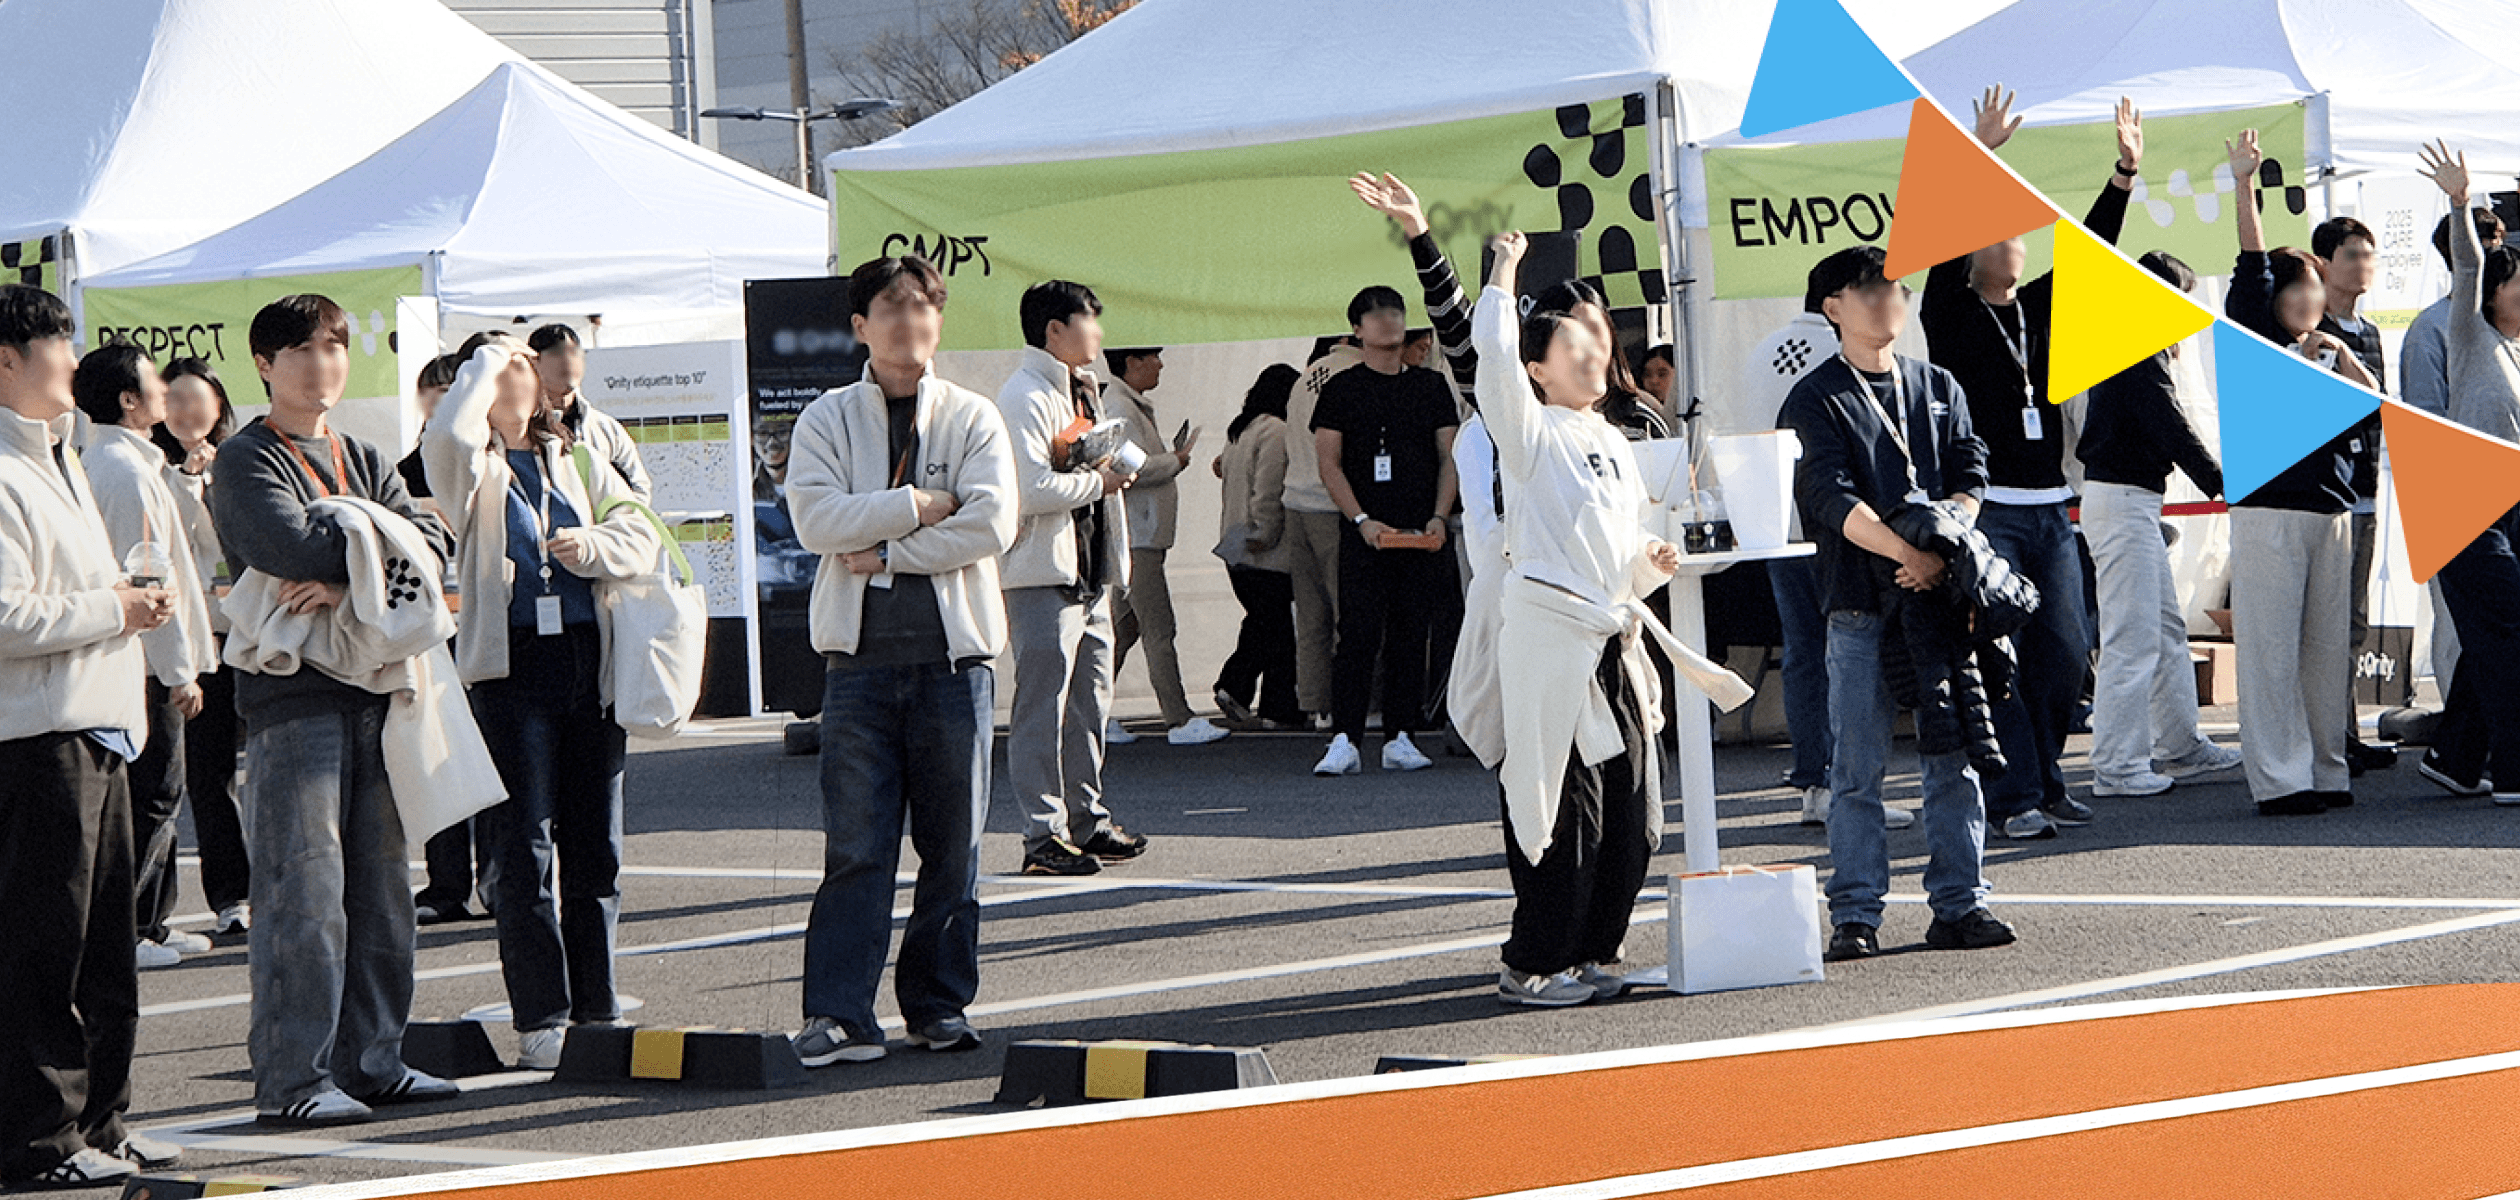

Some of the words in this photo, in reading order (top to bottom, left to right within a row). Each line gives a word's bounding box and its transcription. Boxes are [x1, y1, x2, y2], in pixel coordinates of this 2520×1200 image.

[1730, 193, 1894, 247] EMPO
[2386, 210, 2413, 228] 2025
[2382, 230, 2414, 249] CARE
[2376, 251, 2422, 271] mployee
[2386, 272, 2406, 293] Day
[98, 322, 226, 361] RSPECT
